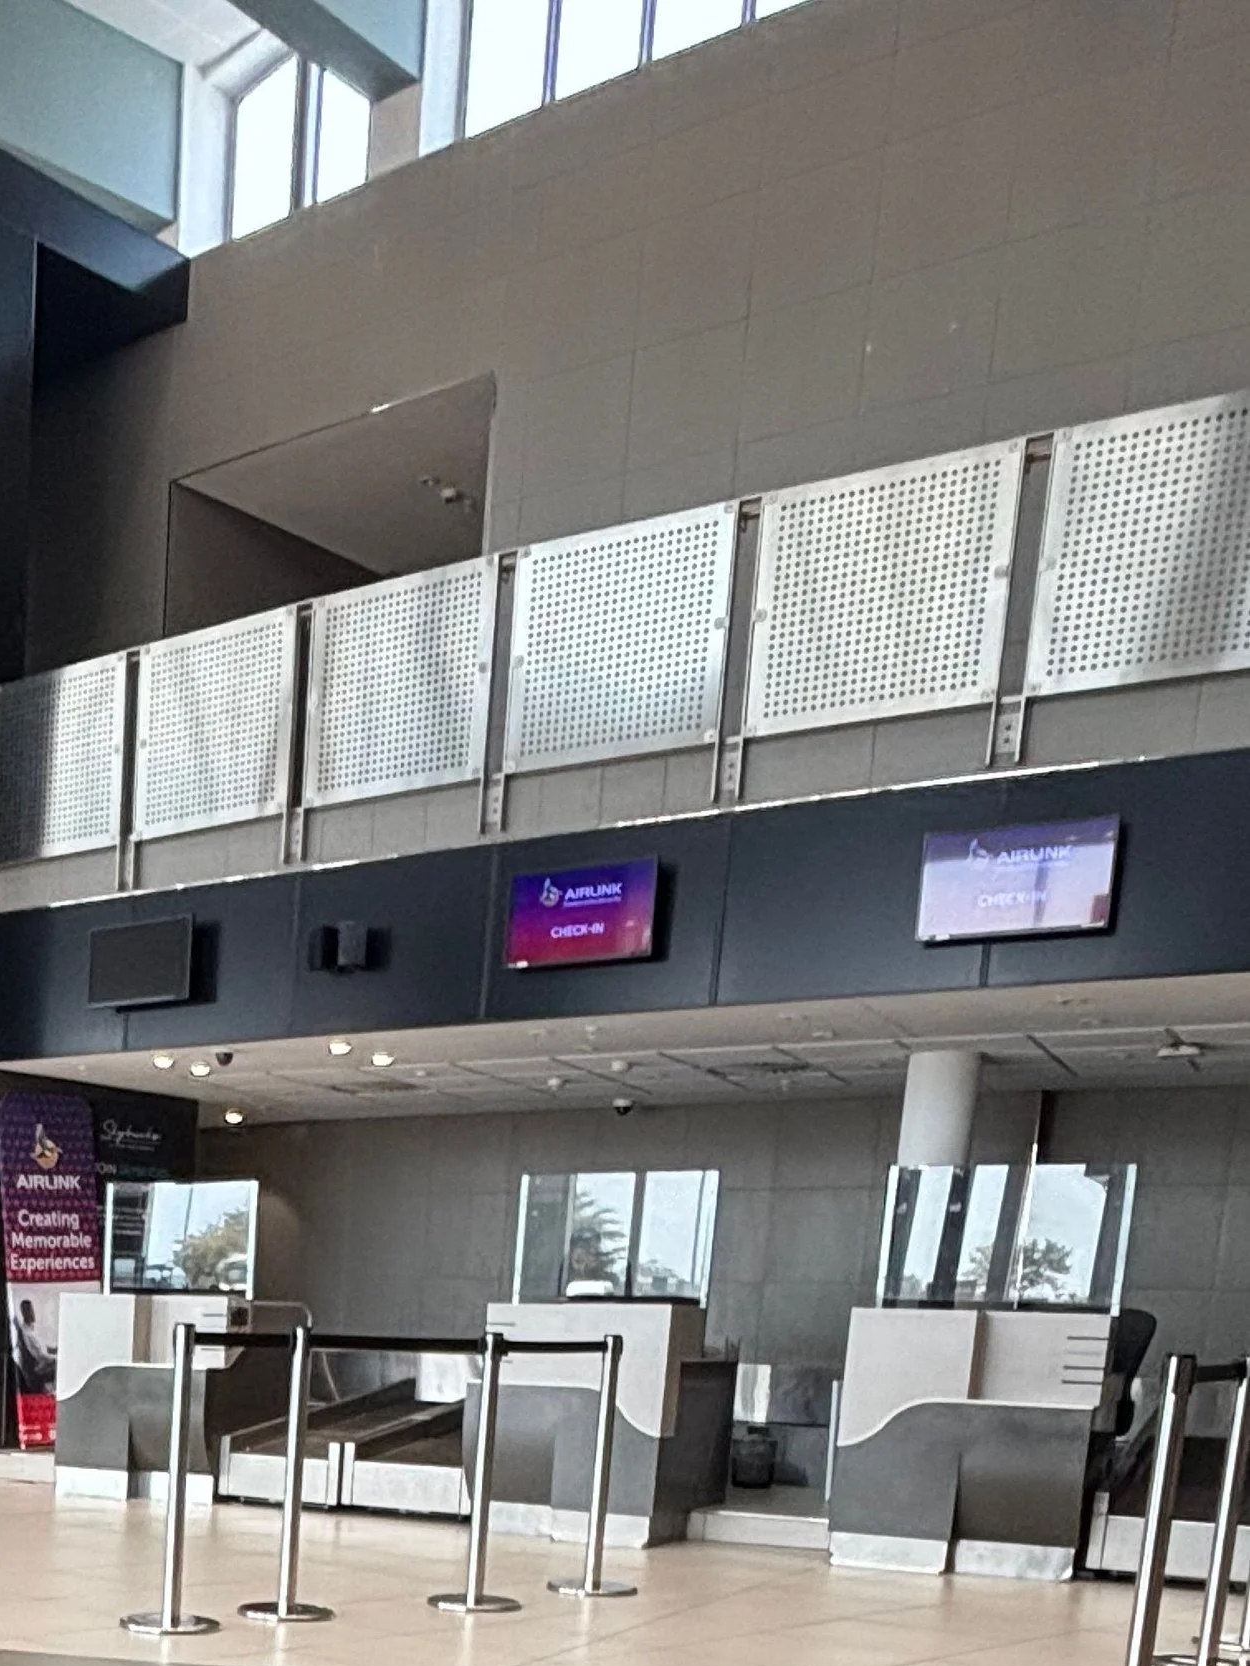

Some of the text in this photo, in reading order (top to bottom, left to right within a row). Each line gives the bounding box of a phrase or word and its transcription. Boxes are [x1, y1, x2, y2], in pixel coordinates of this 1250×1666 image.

[564, 882, 623, 901] AIRLINK
[551, 922, 605, 939] CHECK-IN
[16, 1173, 81, 1190] AIRLINK
[18, 1208, 80, 1230] Creating
[11, 1231, 92, 1249] Memorable
[10, 1253, 95, 1275] Experiences
